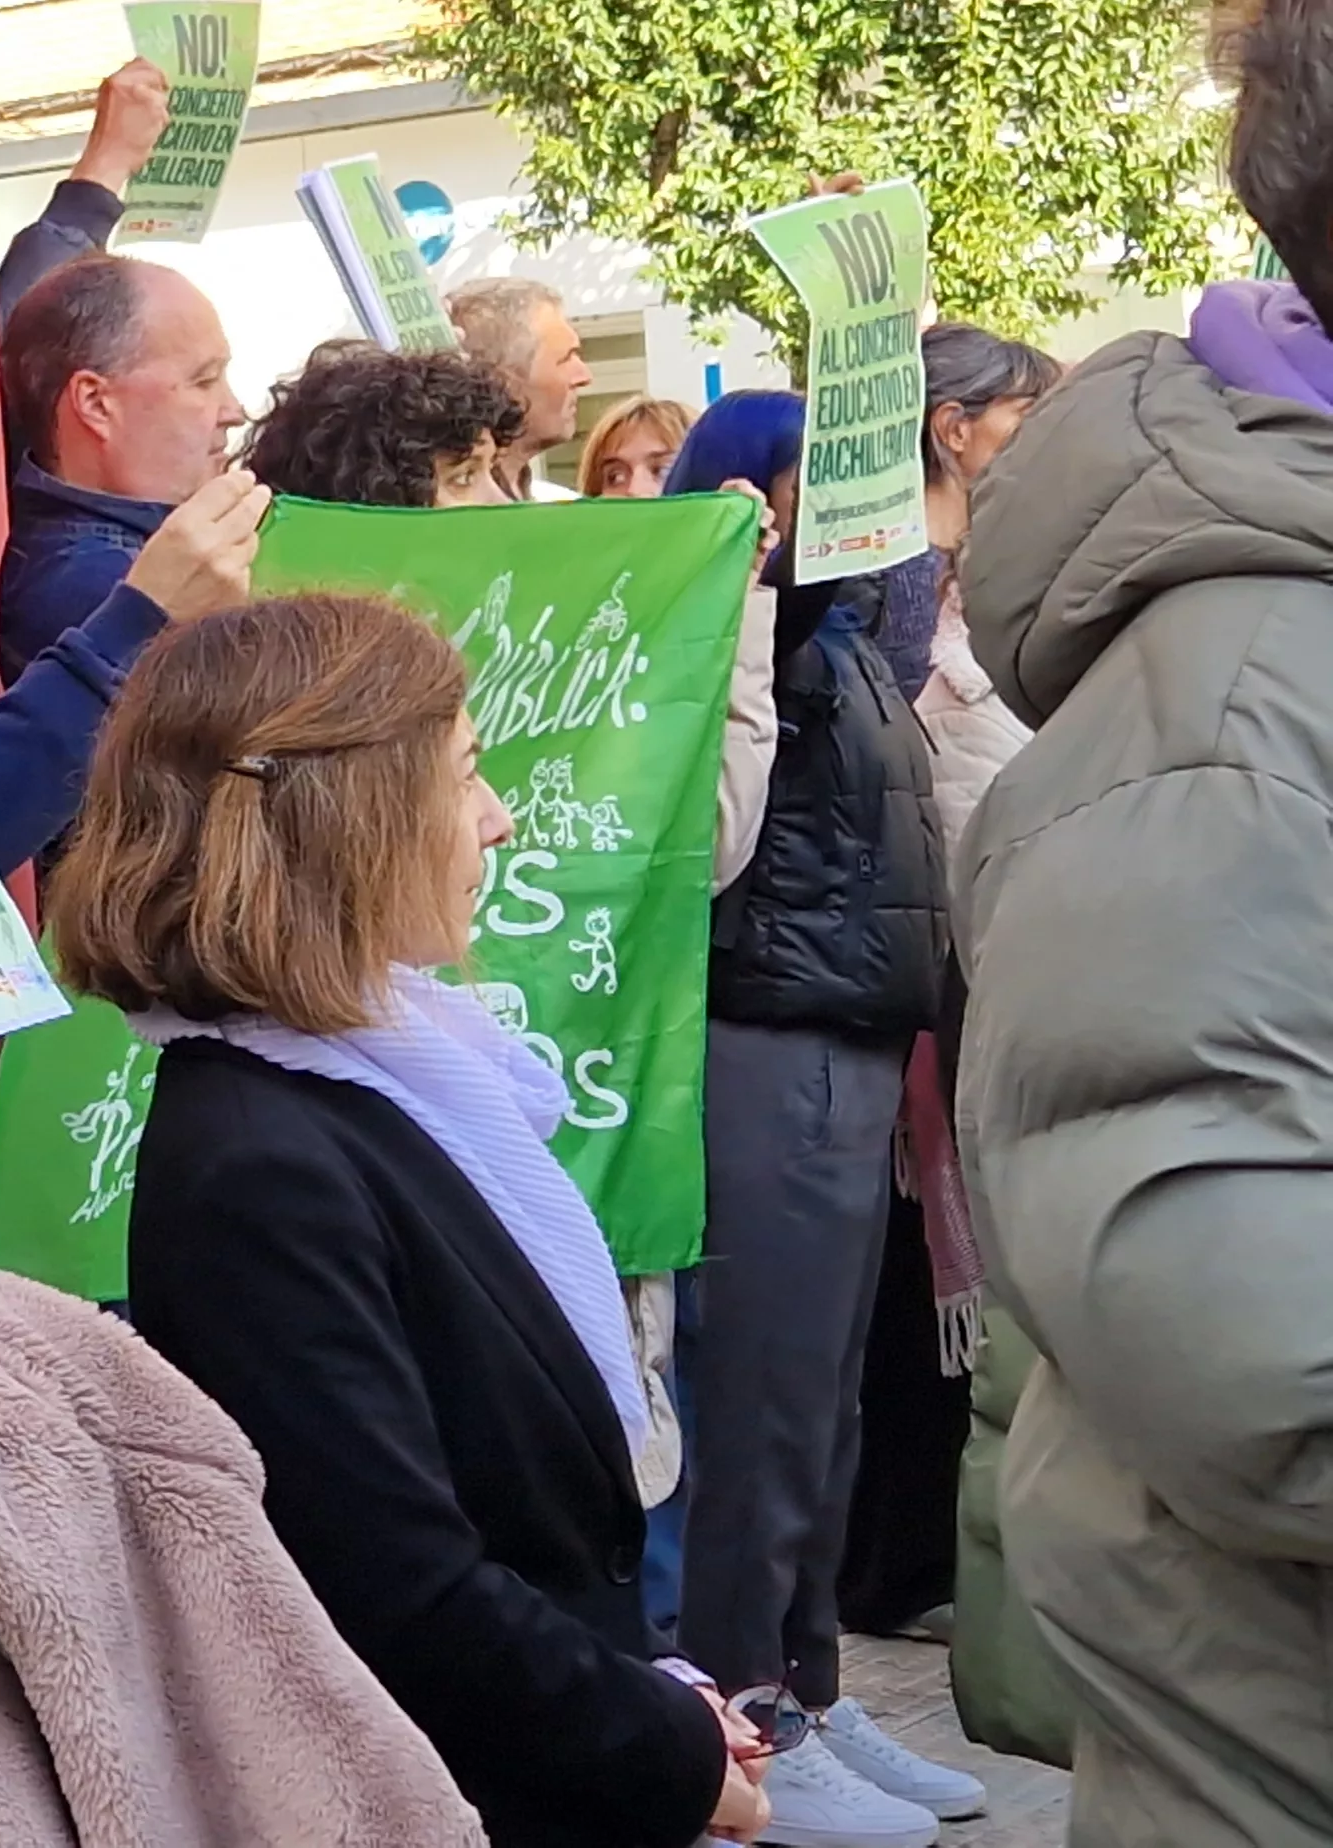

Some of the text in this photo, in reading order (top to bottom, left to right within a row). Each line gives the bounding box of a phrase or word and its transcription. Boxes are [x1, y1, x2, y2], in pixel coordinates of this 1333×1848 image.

[173, 14, 228, 79] NO!
[153, 121, 239, 154] CATIVO EN
[817, 210, 897, 309] NO!
[818, 308, 915, 375] AL CONCIERTO
[816, 362, 919, 431] EDUCATIVO EN
[807, 416, 918, 488] BACHILLERATO
